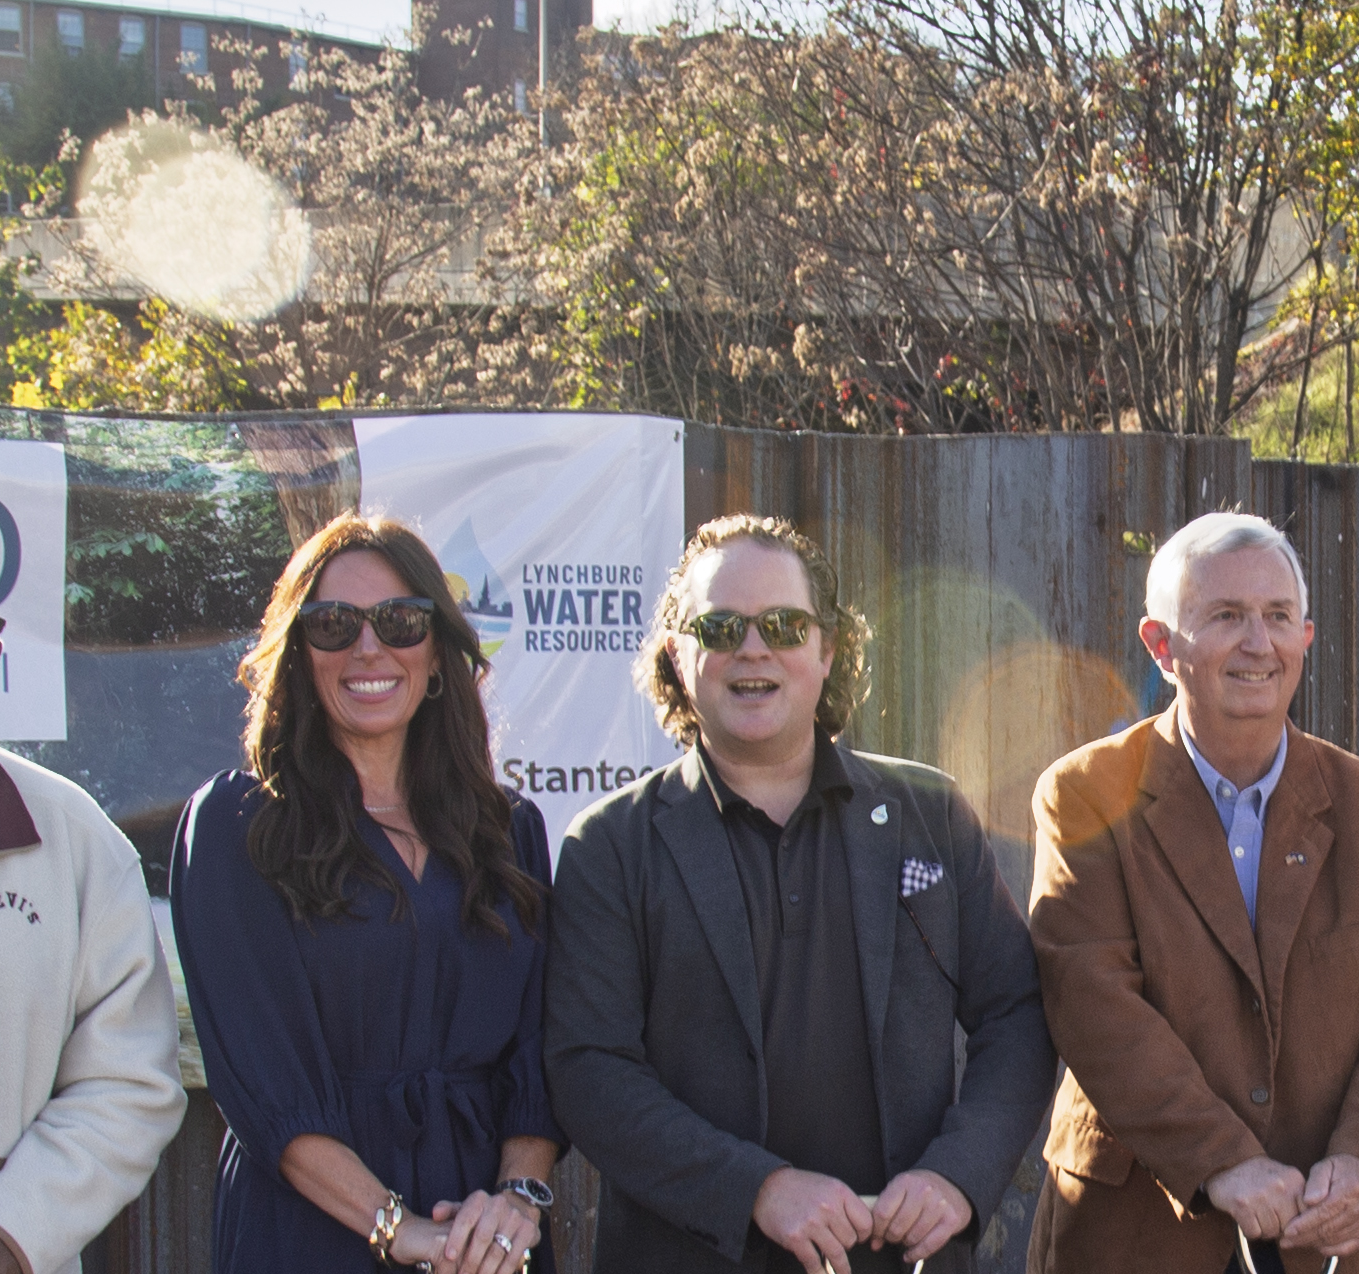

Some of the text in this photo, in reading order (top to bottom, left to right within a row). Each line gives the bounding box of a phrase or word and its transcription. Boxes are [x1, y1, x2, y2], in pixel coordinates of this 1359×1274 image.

[522, 563, 643, 585] LYNCHBURG
[523, 588, 642, 626] WATER
[525, 629, 643, 652] RESOURCES
